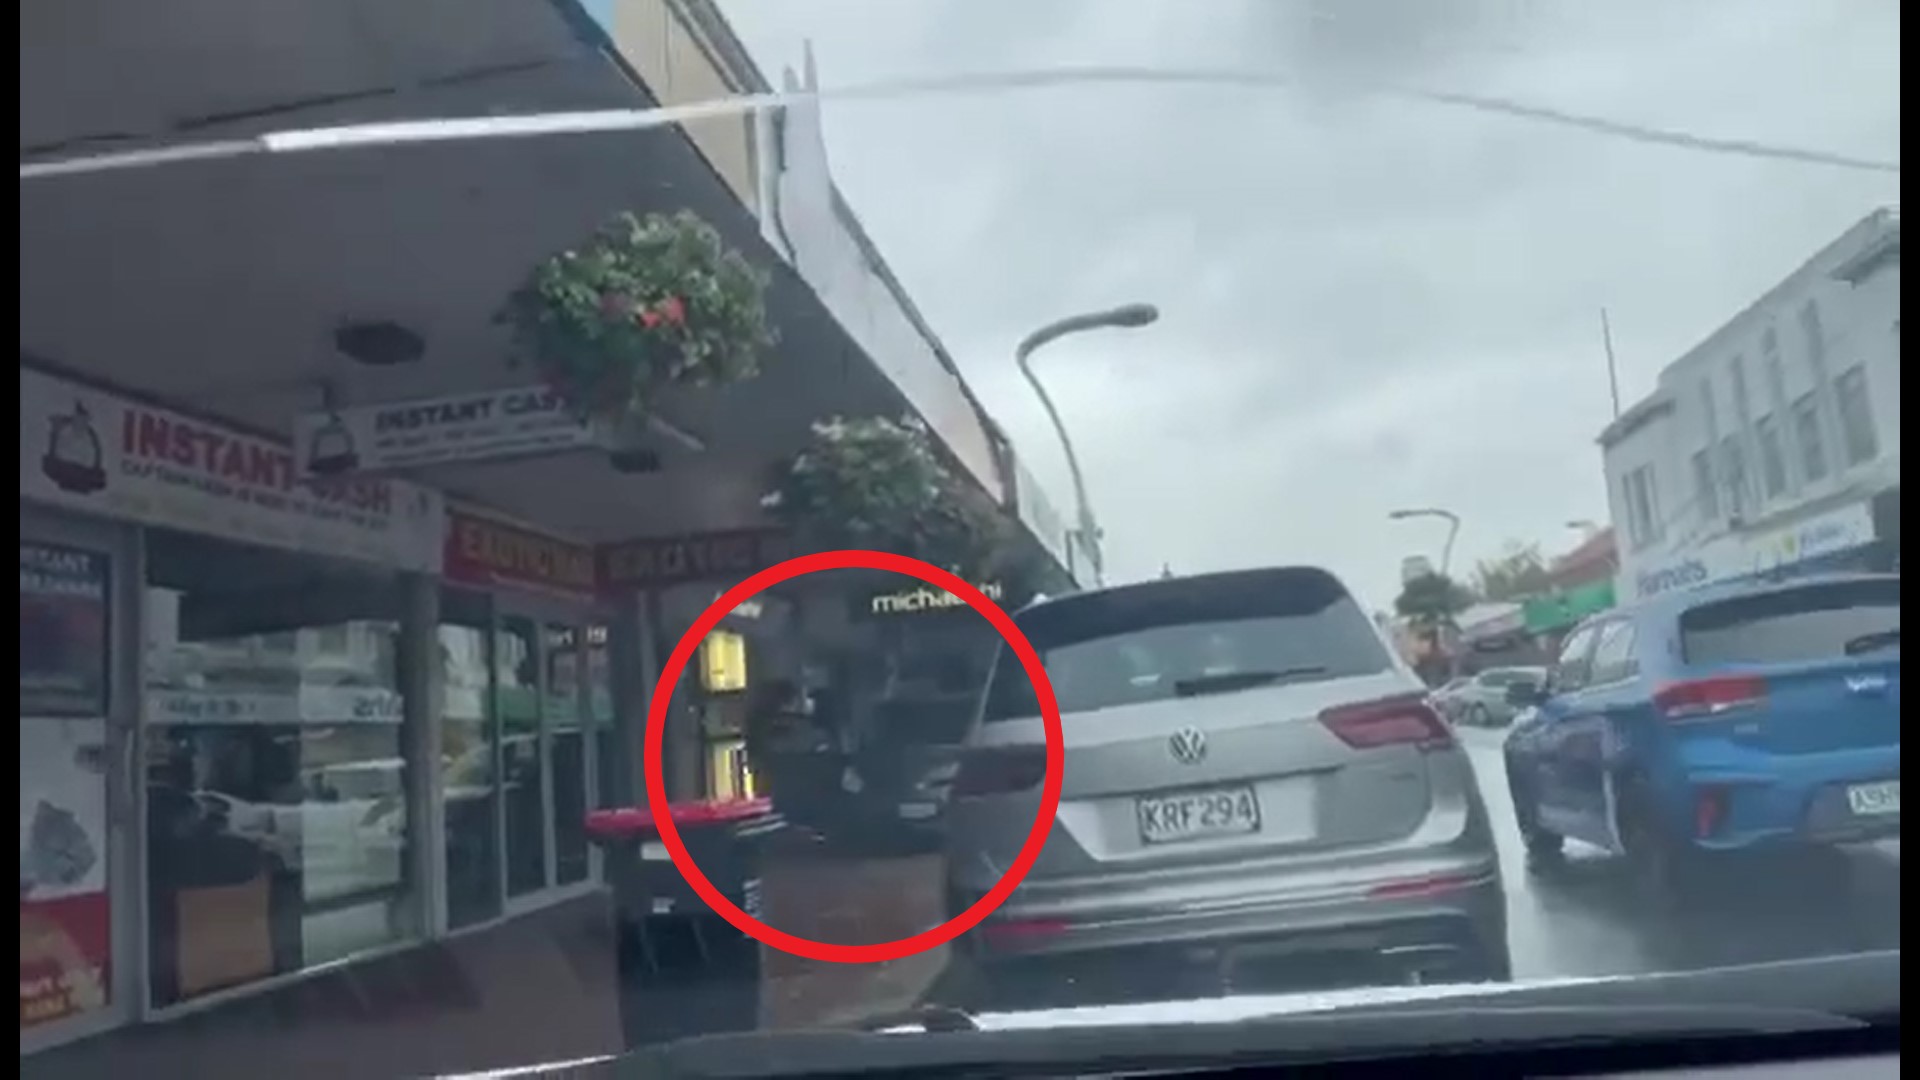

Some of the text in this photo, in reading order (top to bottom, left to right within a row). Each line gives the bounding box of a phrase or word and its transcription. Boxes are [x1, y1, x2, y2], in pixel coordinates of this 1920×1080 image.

[376, 393, 563, 432] INSTANT CAS
[121, 409, 295, 491] INSTANT
[1143, 792, 1252, 831] KRF294
